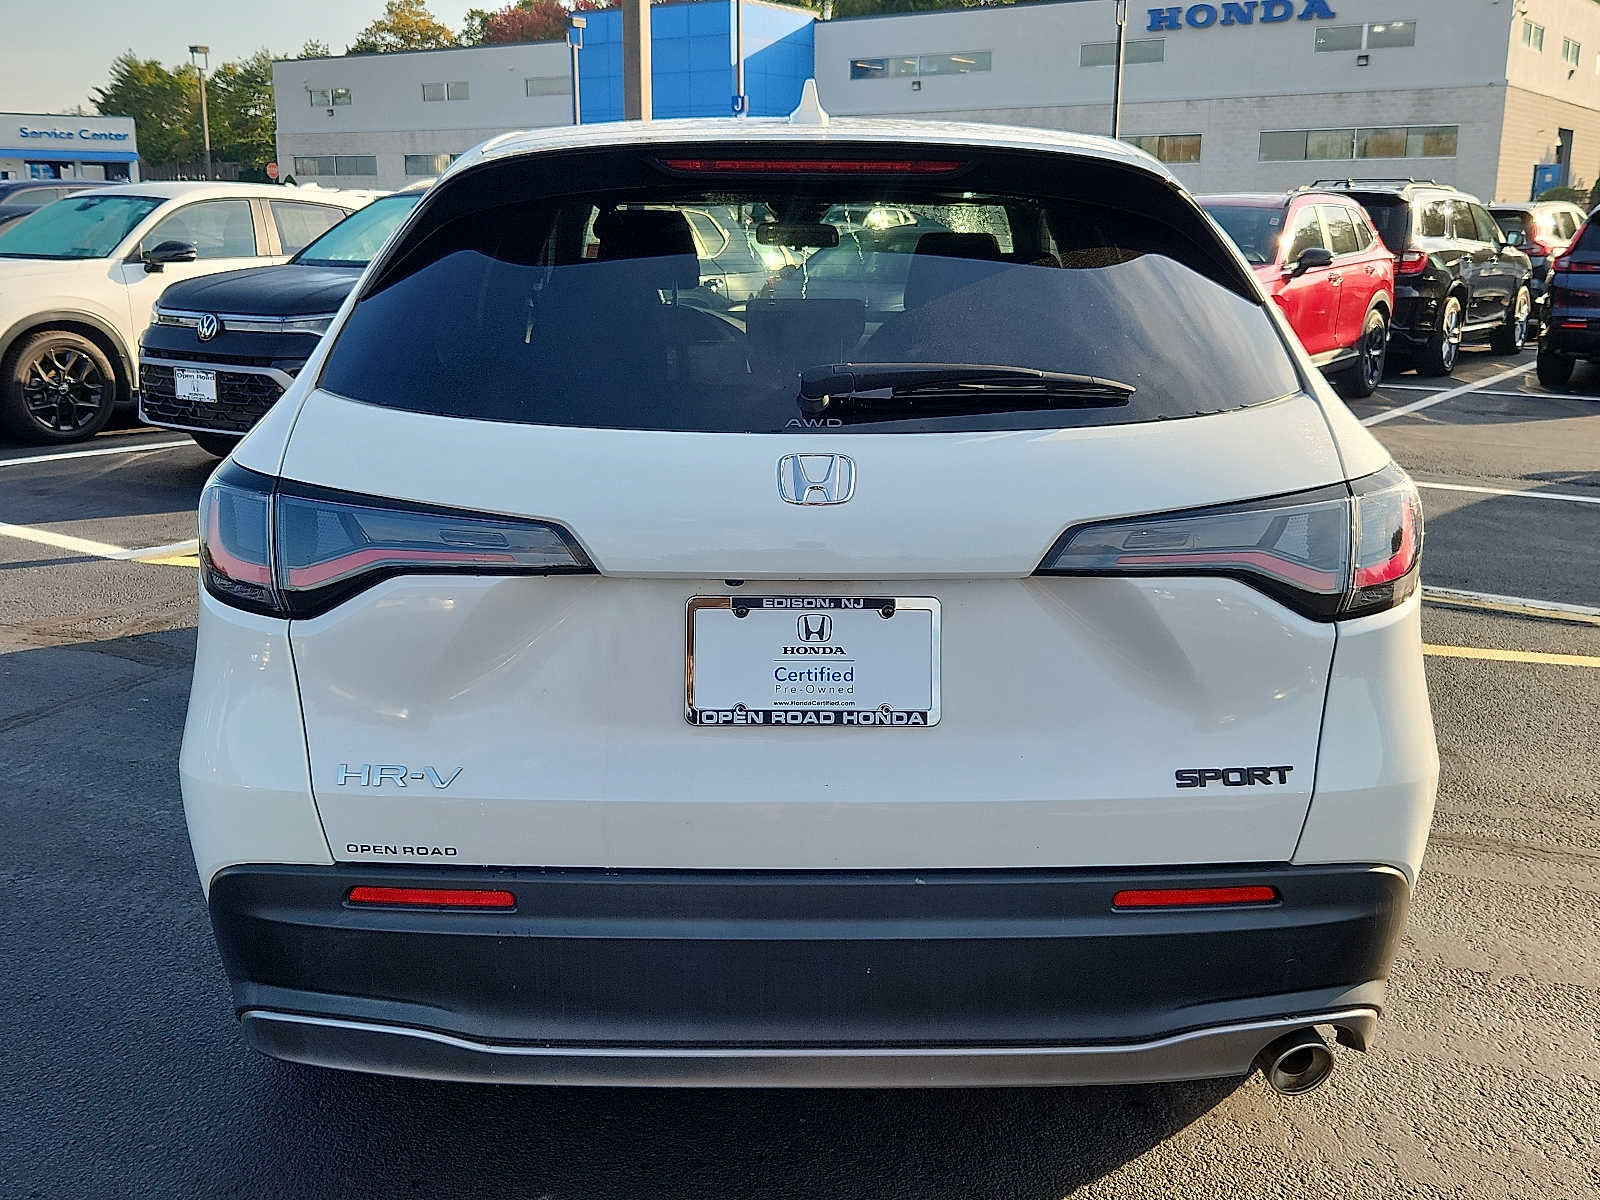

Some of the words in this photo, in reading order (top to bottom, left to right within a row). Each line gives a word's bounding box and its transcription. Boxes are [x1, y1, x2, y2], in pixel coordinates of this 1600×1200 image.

[1146, 0, 1336, 32] HONDA
[734, 97, 742, 110] J
[19, 127, 74, 139] Service
[79, 129, 129, 141] Center
[784, 418, 843, 428] AWD
[762, 598, 835, 609] EDISON,
[841, 598, 864, 609] NJ
[782, 646, 847, 655] HONDA
[774, 666, 854, 682] Certified
[775, 684, 854, 694] Pre-Owned
[701, 711, 764, 724] OPEN
[771, 711, 835, 724] ROAD
[842, 711, 925, 725] HONDA
[337, 763, 464, 789] HR-V
[1175, 766, 1294, 788] SPORT
[346, 844, 398, 855] OPEN
[403, 846, 458, 856] ROAD
